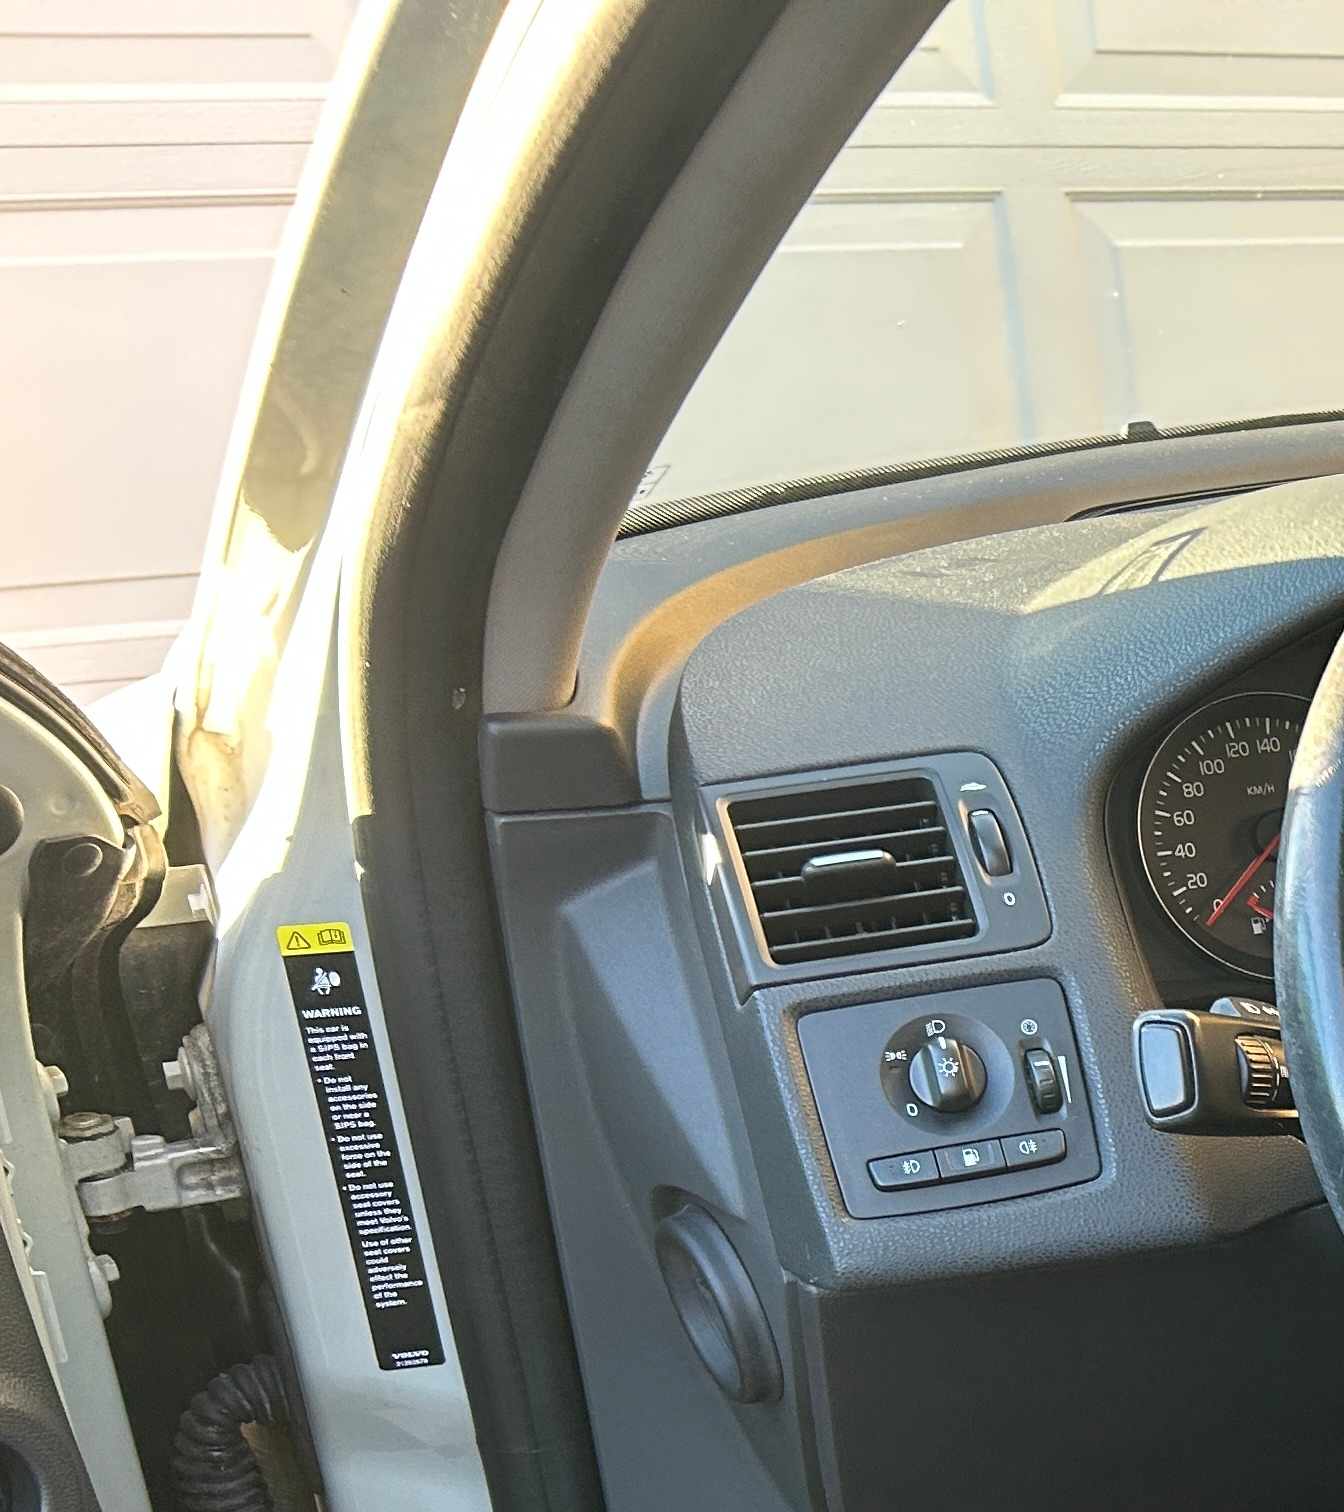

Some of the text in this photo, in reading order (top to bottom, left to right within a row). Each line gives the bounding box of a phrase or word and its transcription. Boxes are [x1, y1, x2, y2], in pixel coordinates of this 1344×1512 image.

[1225, 742, 1250, 758] 120
[1256, 737, 1281, 754] 140
[1199, 759, 1225, 776] 100
[1182, 782, 1204, 798] 80
[1246, 783, 1275, 796] KM/H
[1174, 810, 1195, 826] 60
[1174, 842, 1196, 858] 40
[1186, 872, 1208, 888] 20
[302, 1006, 362, 1019] WARNING
[305, 1027, 324, 1035] This
[341, 1024, 350, 1032] is
[308, 1032, 368, 1044] equipped with
[318, 1044, 340, 1053] SIPS
[342, 1043, 358, 1051] bag
[312, 1052, 356, 1062] each front
[314, 1063, 335, 1072] seat.
[324, 1076, 336, 1085] Do
[325, 1084, 368, 1093] install any
[328, 1093, 378, 1102] accessories
[330, 1102, 377, 1112] on the side
[332, 1112, 342, 1120] or
[342, 1112, 362, 1120] near
[334, 1120, 376, 1130] SIPS bag.
[337, 1135, 350, 1143] Do
[367, 1132, 384, 1140] use
[339, 1142, 381, 1152] excessive
[341, 1152, 363, 1161] force
[376, 1150, 392, 1158] the
[343, 1162, 362, 1170] side
[363, 1160, 372, 1168] of
[345, 1170, 367, 1179] seat.
[348, 1184, 362, 1192] Do
[362, 1182, 377, 1190] not
[350, 1190, 393, 1200] accessory
[352, 1198, 400, 1209] seat covers
[354, 1207, 402, 1218] unless they
[356, 1215, 410, 1226] meet Volvo's
[358, 1224, 412, 1236] specification.
[361, 1240, 379, 1248] Use
[390, 1236, 413, 1244] other
[364, 1246, 411, 1256] seat covers
[366, 1257, 389, 1266] could
[368, 1264, 407, 1274] adversely
[371, 1280, 424, 1292] performance
[374, 1292, 382, 1300] of
[376, 1300, 408, 1309] system.
[392, 1350, 430, 1360] VOLVO
